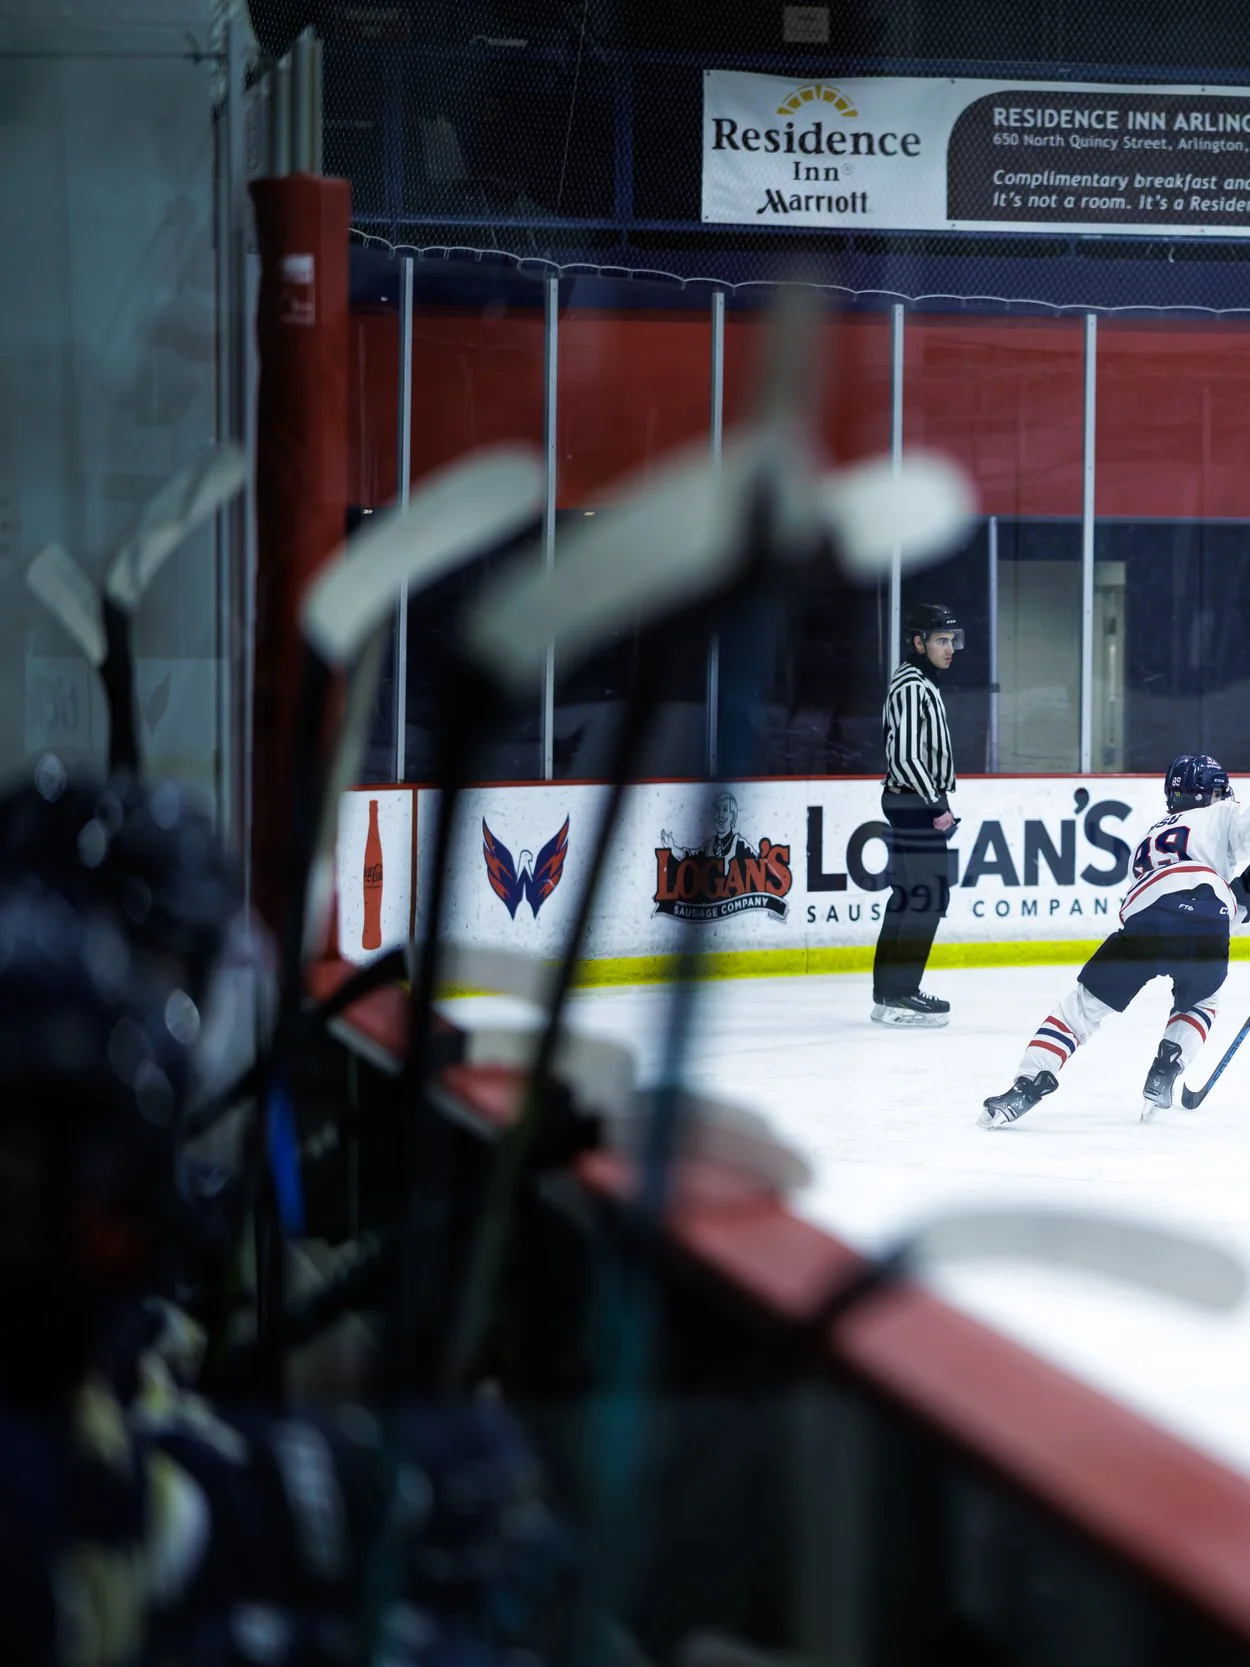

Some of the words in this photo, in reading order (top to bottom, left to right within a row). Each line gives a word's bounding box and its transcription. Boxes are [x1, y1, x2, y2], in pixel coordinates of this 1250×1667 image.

[993, 107, 1119, 130] RESIDENCE
[1127, 111, 1166, 130] INN
[711, 117, 921, 157] Residence
[993, 133, 1019, 146] 650
[1023, 134, 1064, 147] North
[1069, 135, 1119, 150] Quincy
[1123, 136, 1173, 151] Street,
[1178, 138, 1249, 153] Arlington,
[993, 169, 1129, 191] Complimentary
[1133, 172, 1218, 192] breakfast
[756, 187, 868, 214] Marriott
[993, 192, 1022, 207] It's
[1027, 193, 1057, 208] not
[1063, 196, 1075, 208] a
[1080, 196, 1132, 209] room.
[1138, 194, 1168, 210] It's
[1173, 198, 1184, 210] a
[1171, 776, 1182, 787] 89
[807, 788, 1132, 892] LOAN'S
[654, 837, 792, 901] LOGAN'S
[721, 896, 769, 915] COMPANY
[973, 898, 1124, 917] COMPAN
